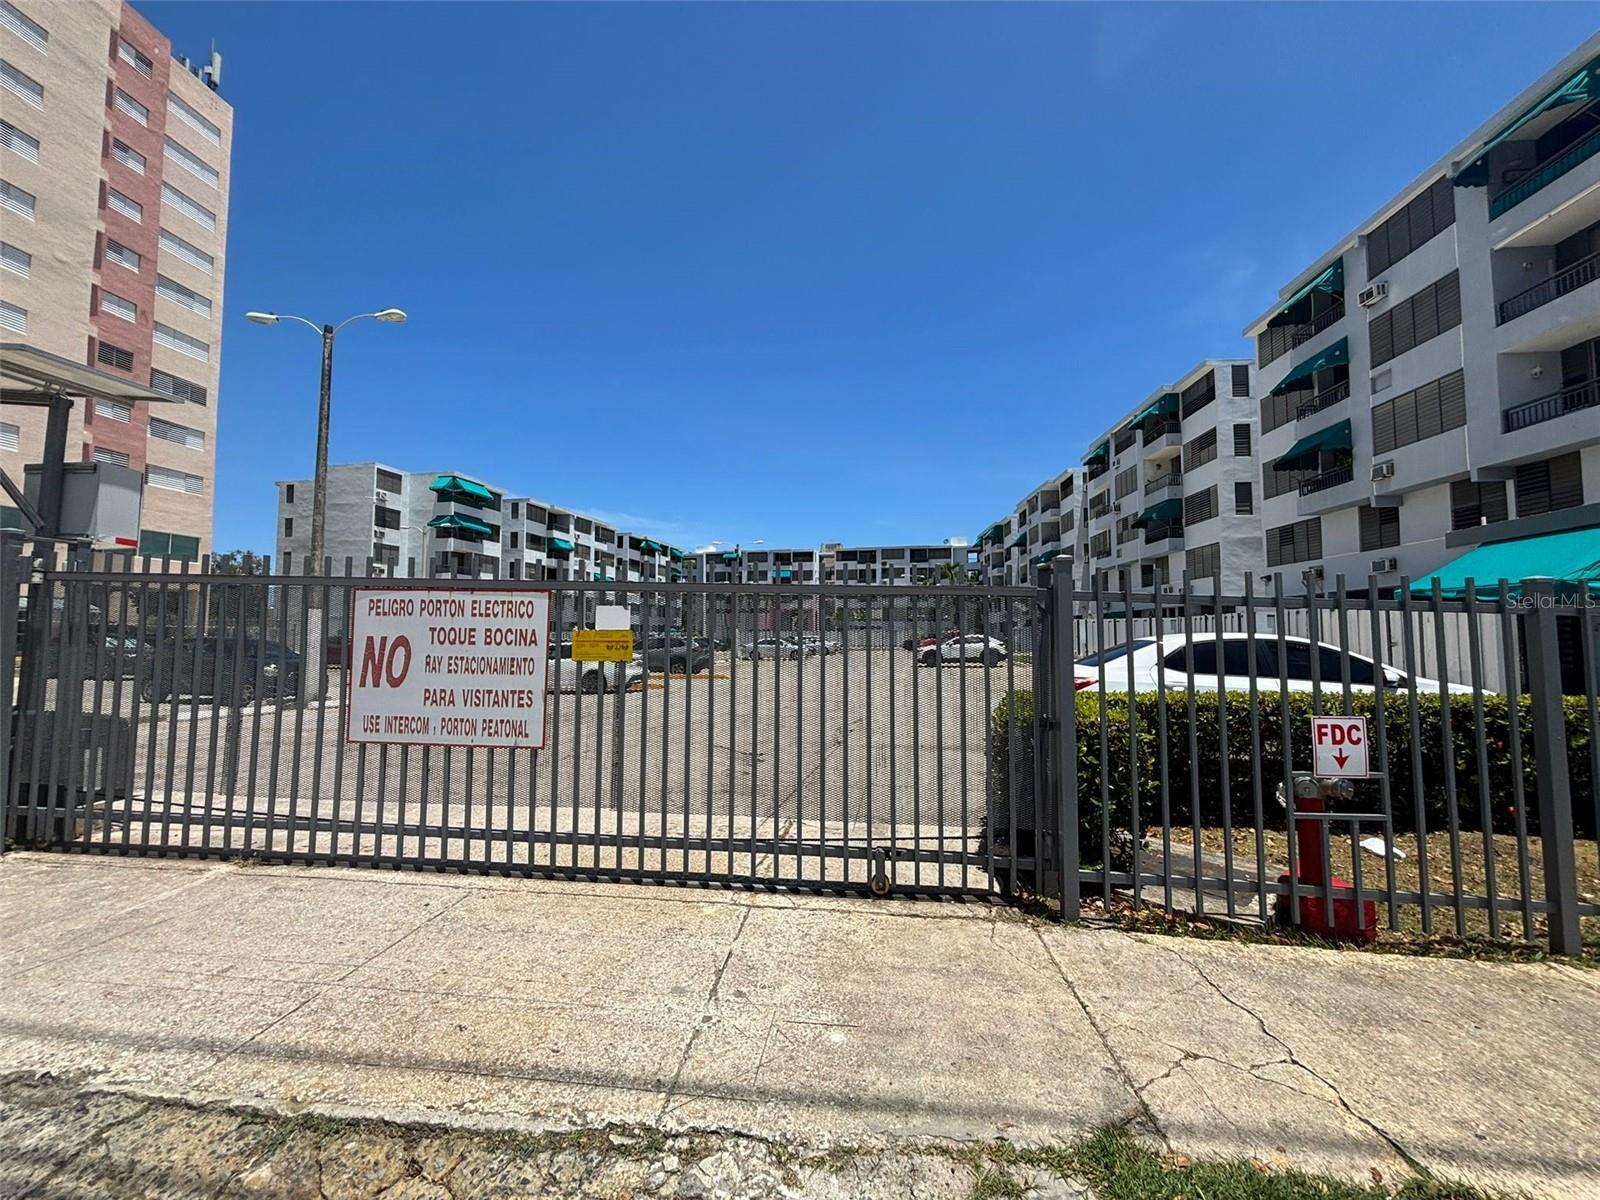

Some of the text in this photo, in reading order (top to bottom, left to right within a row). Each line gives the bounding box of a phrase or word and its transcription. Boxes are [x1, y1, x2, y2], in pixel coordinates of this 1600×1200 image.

[368, 599, 534, 619] PELIGRO PORTON ELECTRICO
[429, 627, 538, 647] TOQUE BOCINA
[359, 635, 412, 688] NO
[448, 656, 535, 676] ESTACIONAMIENTO
[424, 688, 534, 708] PARA VISITANTES
[363, 715, 380, 734] USE
[385, 716, 430, 735] INTERCOM
[440, 718, 477, 736] PORTON
[482, 719, 528, 738] PEATONAL
[1316, 724, 1362, 746] FDC
